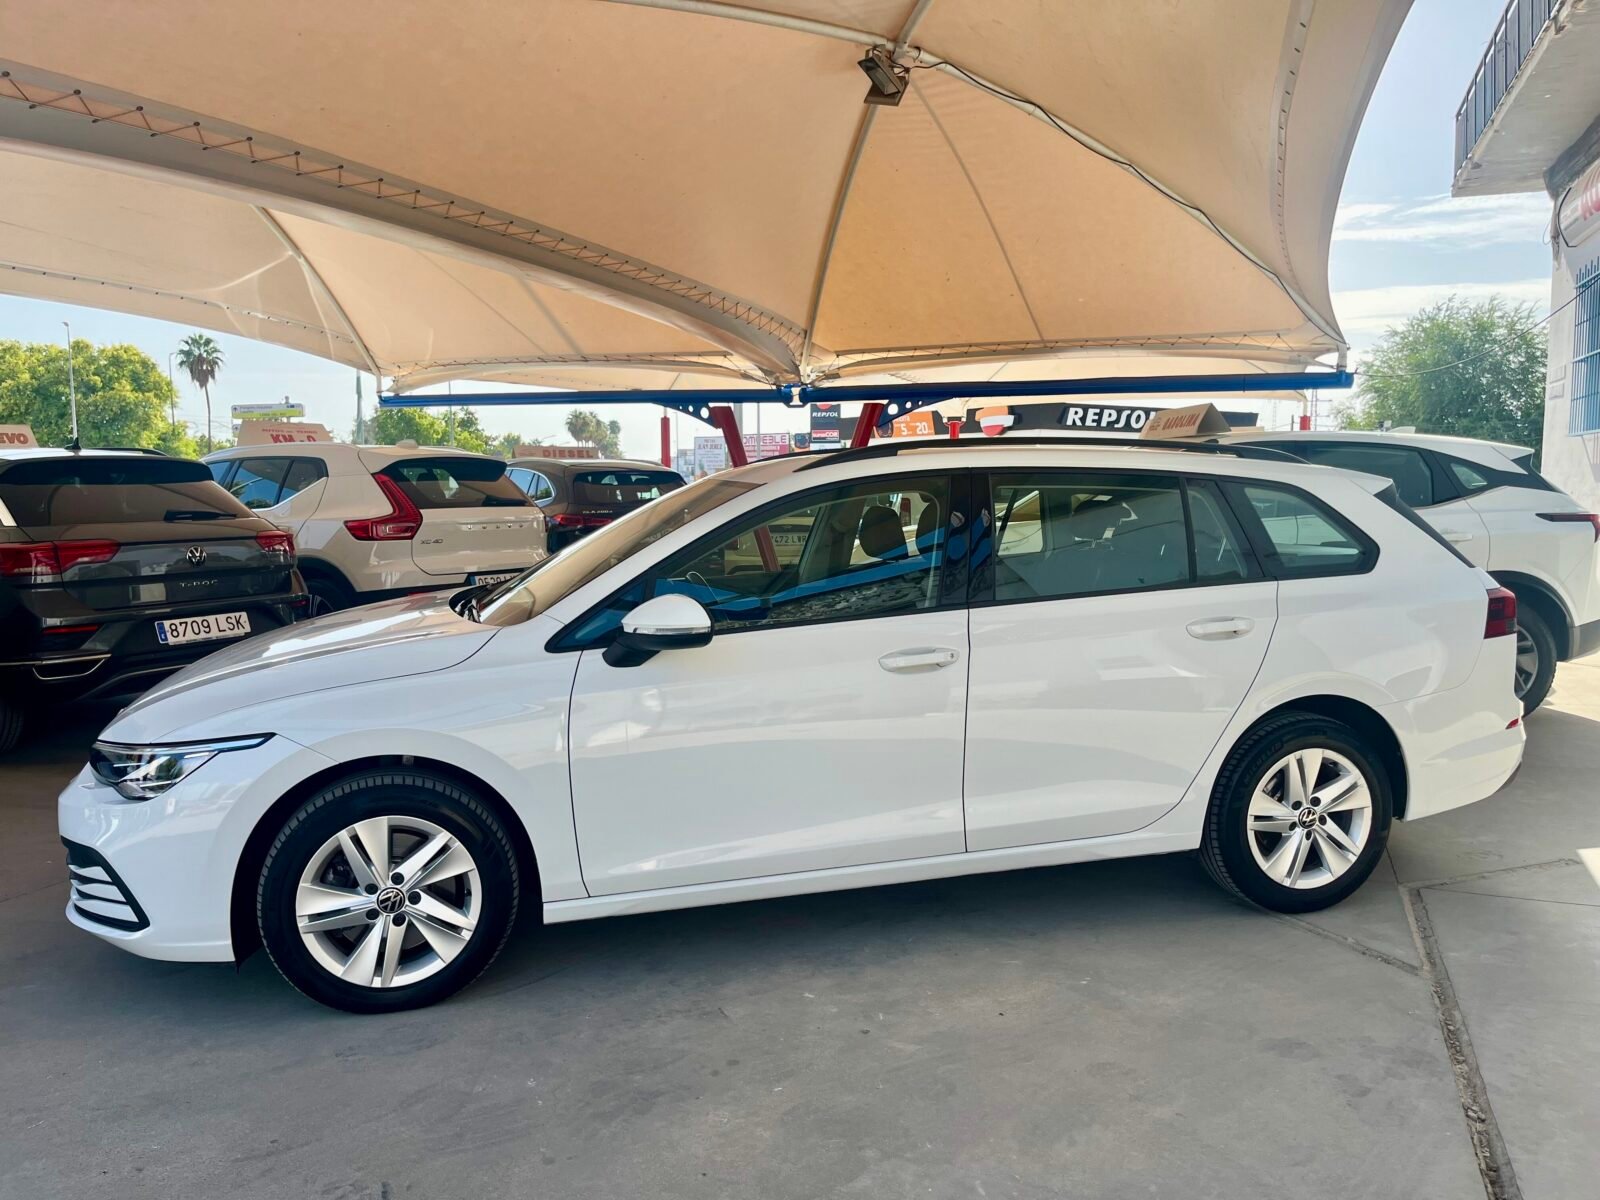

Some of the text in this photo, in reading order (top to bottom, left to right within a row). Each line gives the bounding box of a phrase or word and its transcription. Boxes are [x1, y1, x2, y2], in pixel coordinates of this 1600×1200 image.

[542, 449, 594, 458] DIESEL
[168, 614, 246, 639] 8709 LSK
